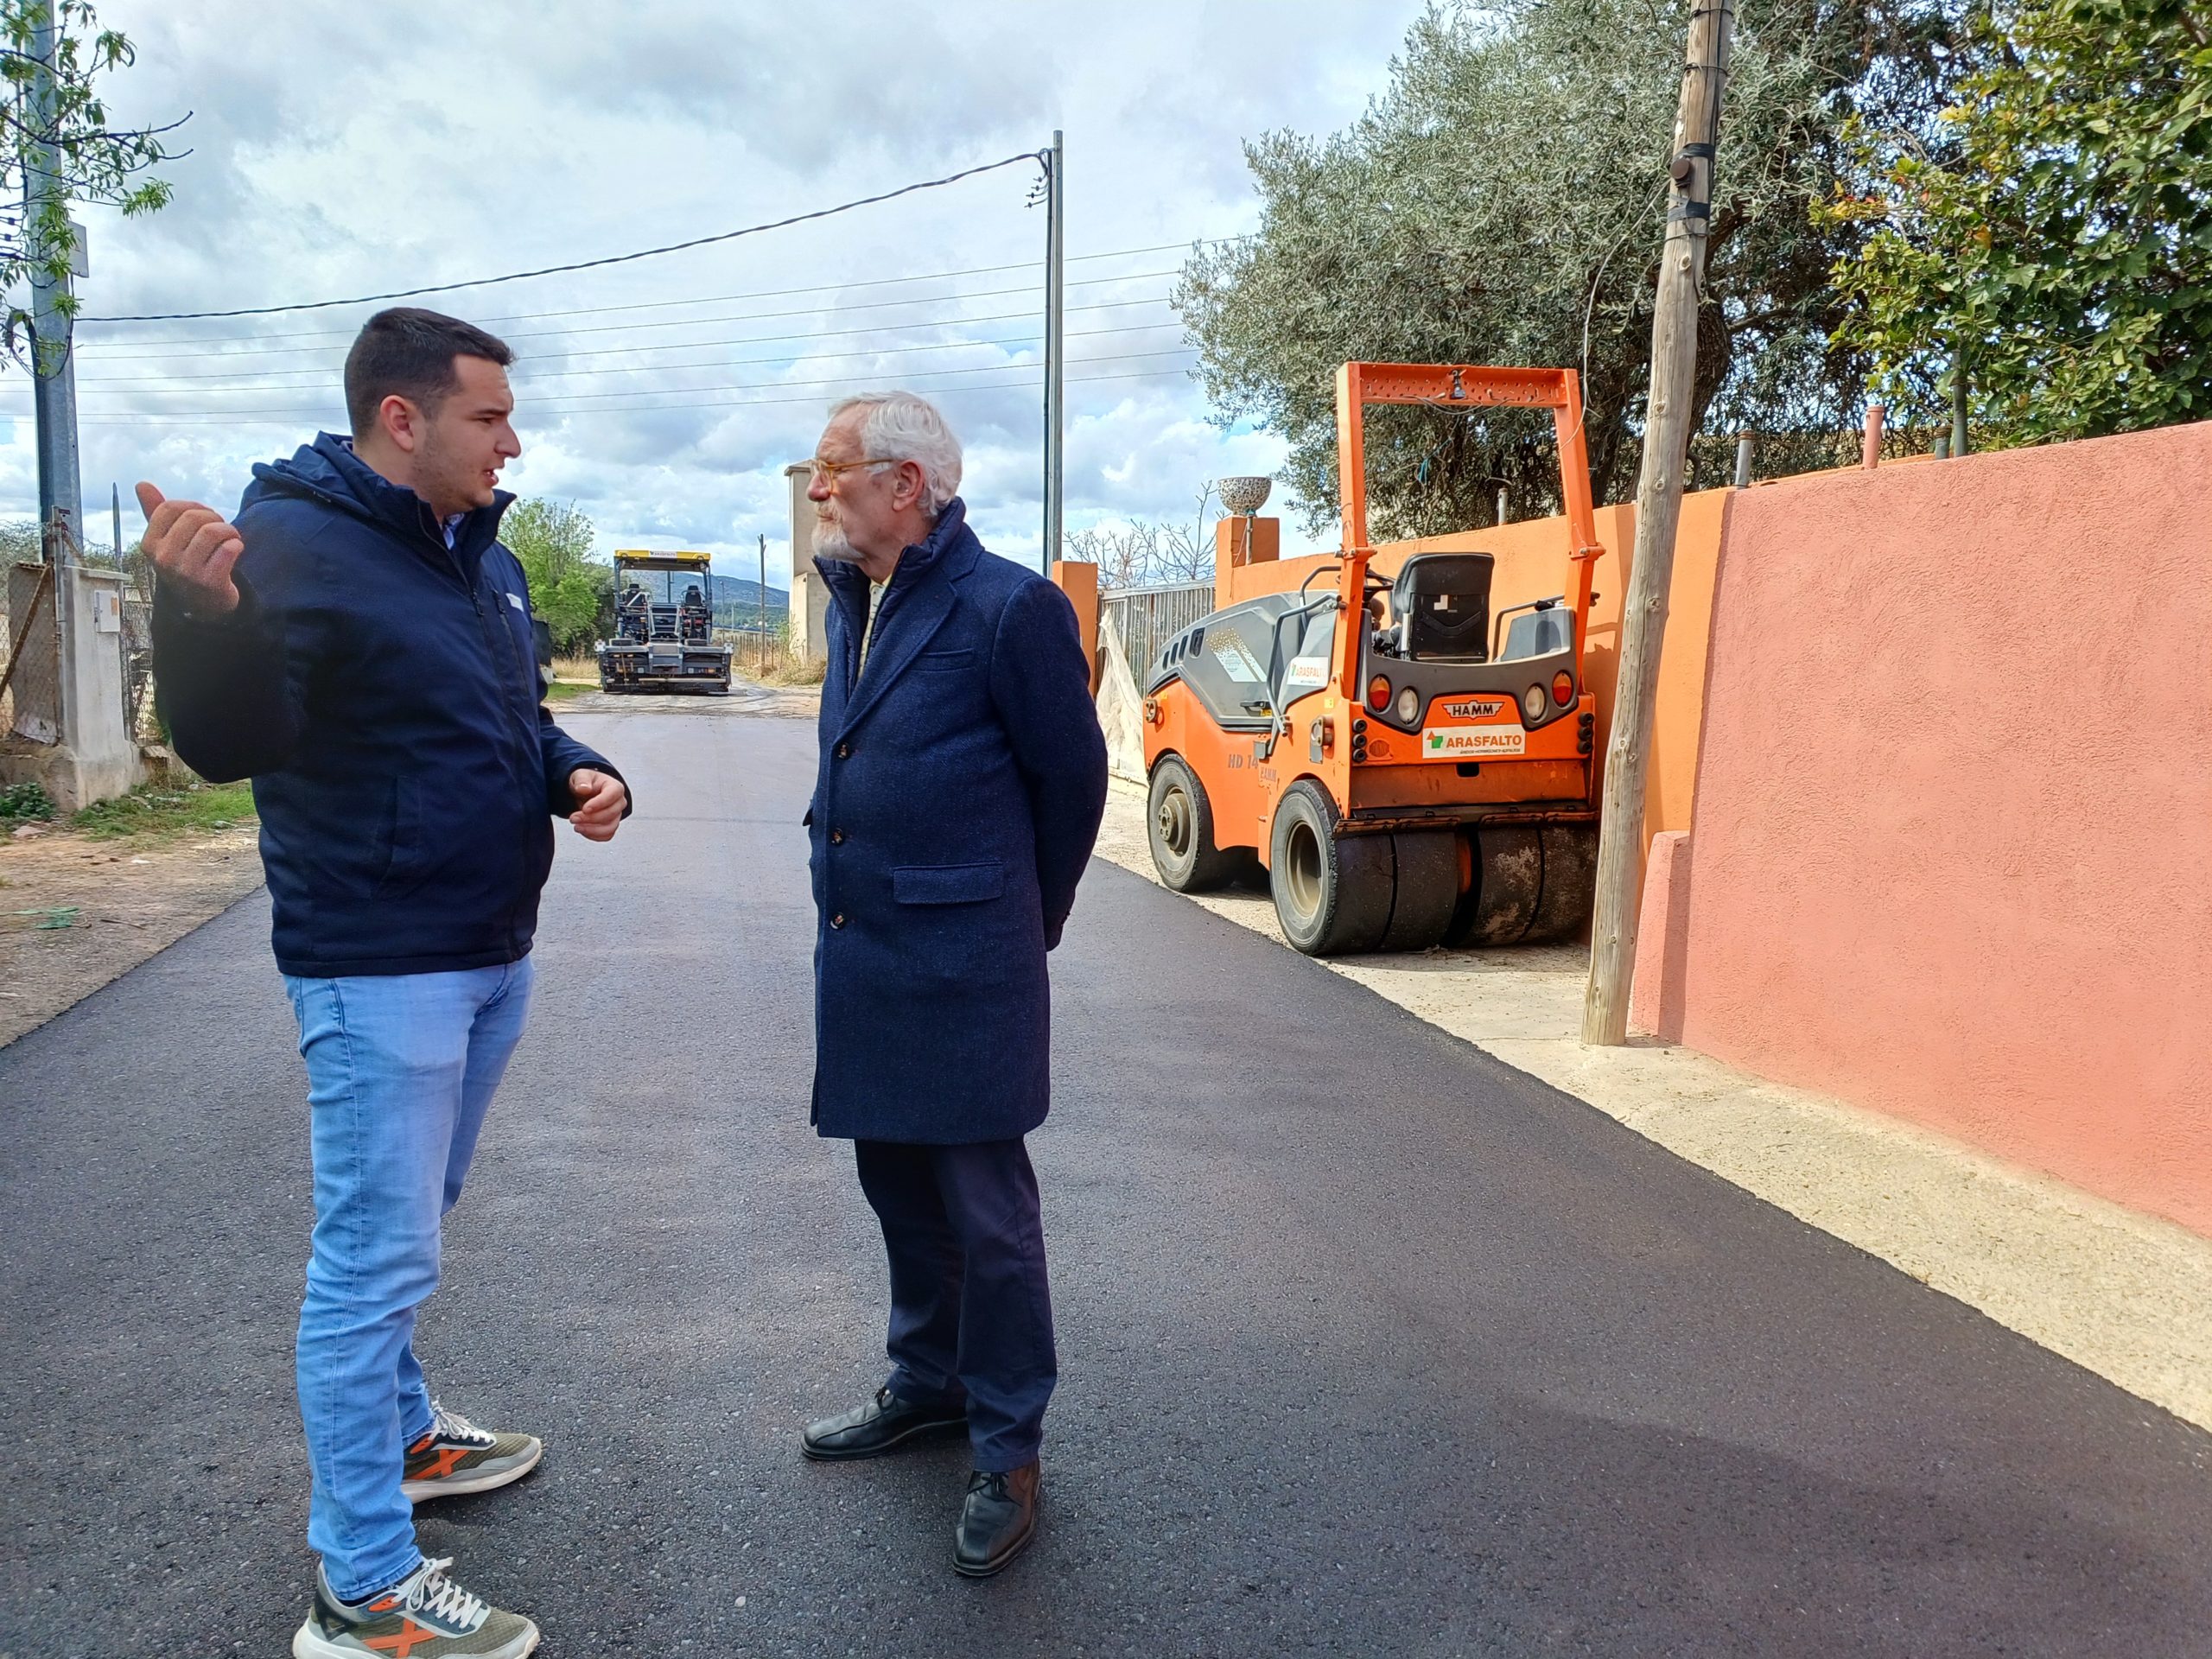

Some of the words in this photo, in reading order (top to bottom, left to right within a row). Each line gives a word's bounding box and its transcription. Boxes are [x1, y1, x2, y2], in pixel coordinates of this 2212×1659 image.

[1452, 704, 1493, 716] HAMM
[1446, 734, 1522, 748] ARASFALTO
[1228, 753, 1243, 769] HD
